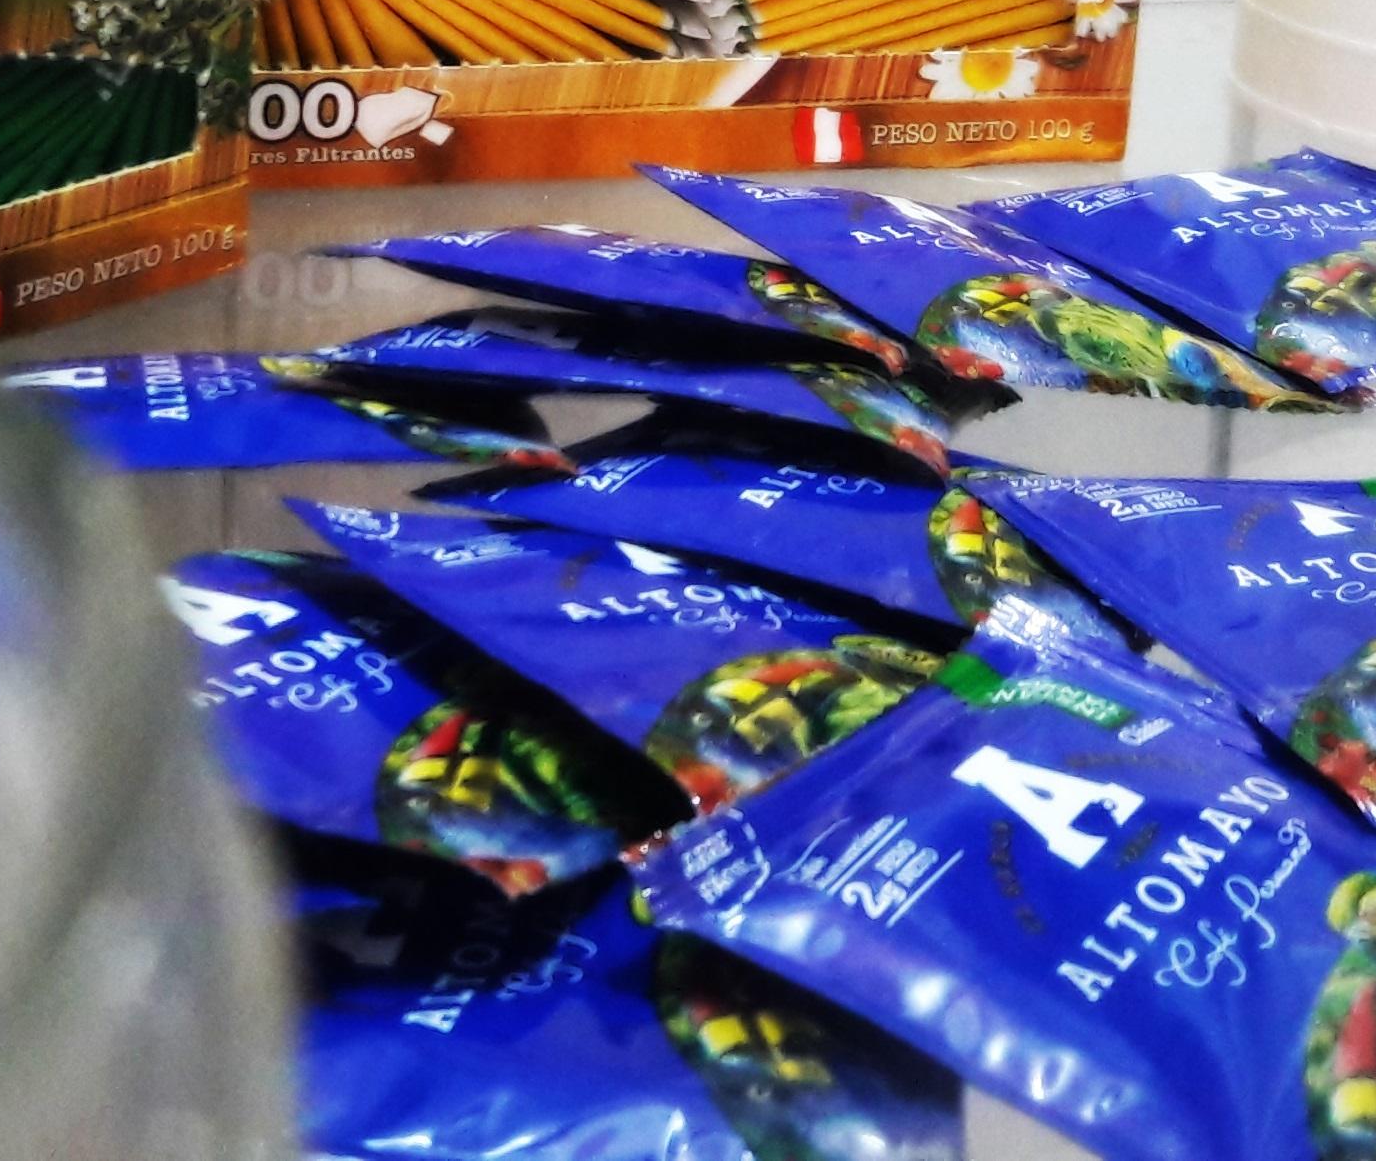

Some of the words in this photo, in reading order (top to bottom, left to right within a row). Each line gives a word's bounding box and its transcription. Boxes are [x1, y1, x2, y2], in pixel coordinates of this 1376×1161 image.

[294, 144, 417, 165] Filtrantes
[871, 122, 938, 146] PESO
[944, 120, 1018, 143] NETO
[1027, 118, 1072, 140] 100
[1079, 120, 1096, 144] g
[1175, 171, 1289, 203] A
[14, 267, 85, 307] PESO
[92, 244, 163, 285] NETO
[172, 229, 216, 261] 100
[951, 744, 1146, 869] A
[1056, 775, 1291, 1003] ALTOMAYO
